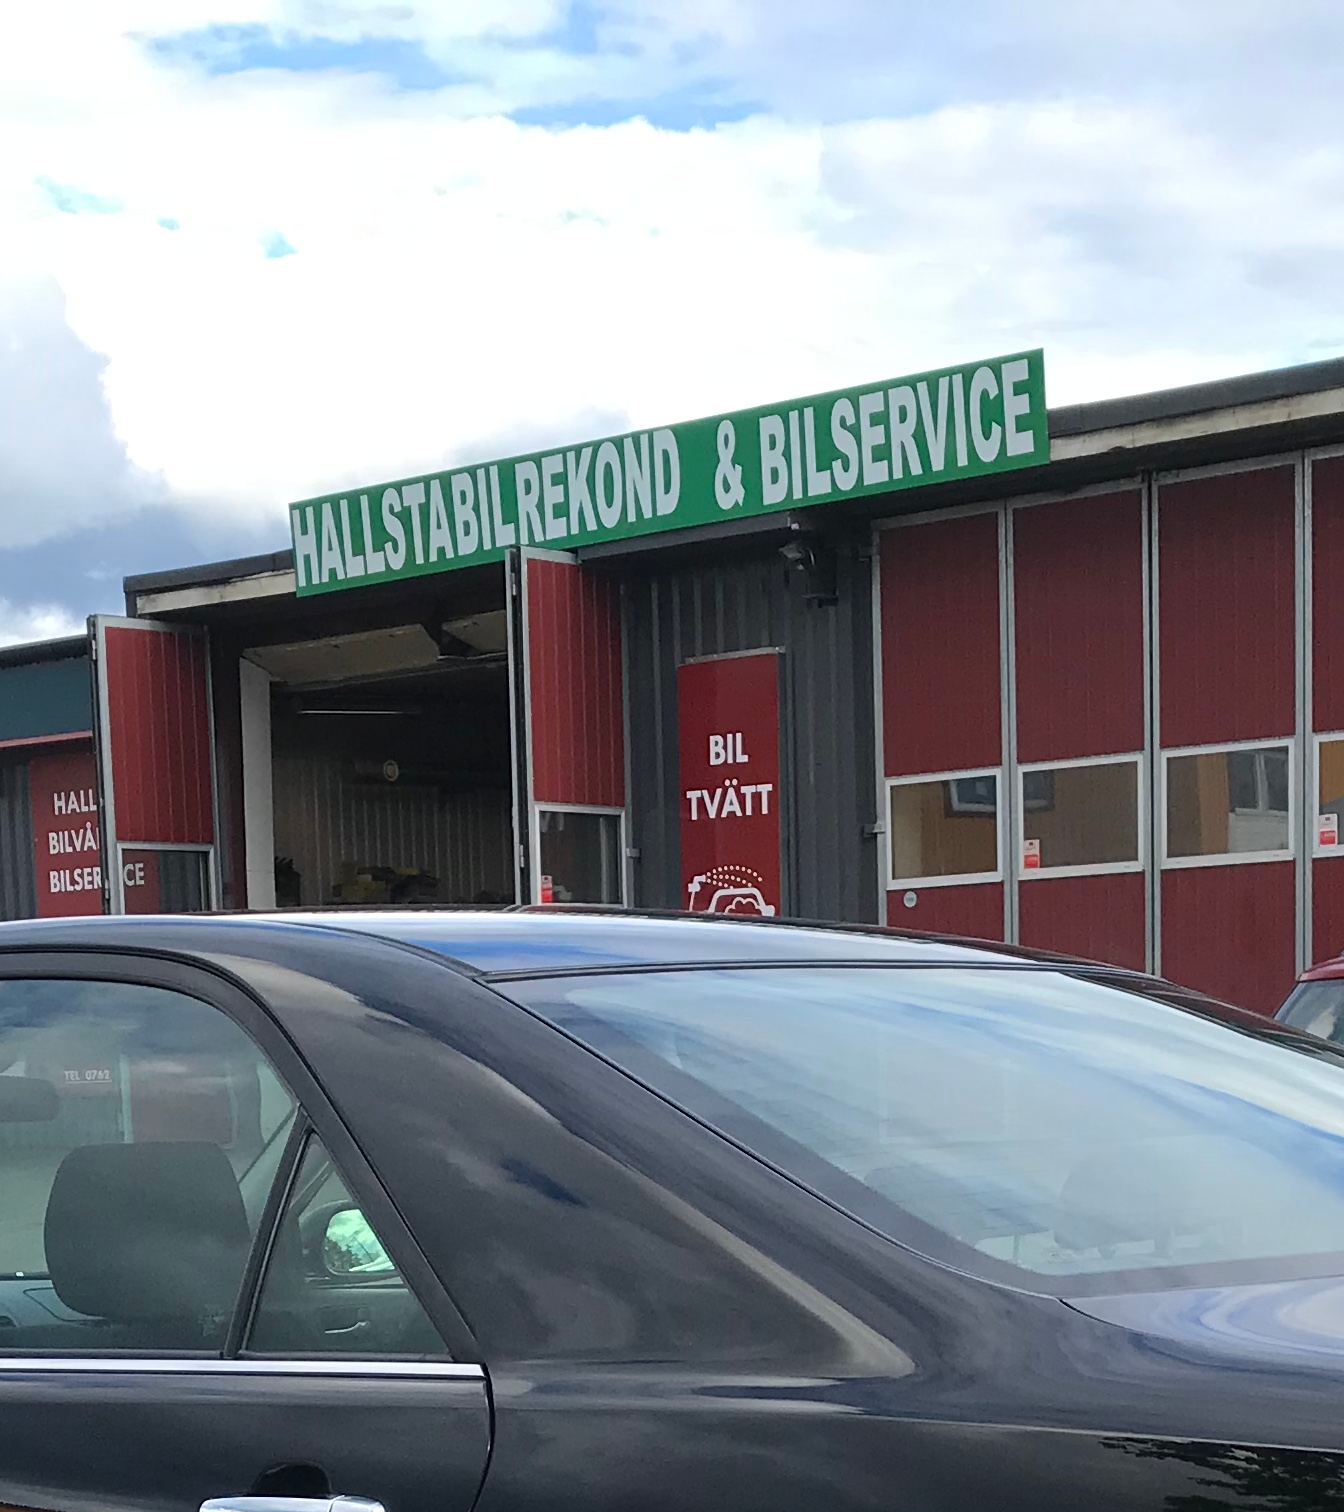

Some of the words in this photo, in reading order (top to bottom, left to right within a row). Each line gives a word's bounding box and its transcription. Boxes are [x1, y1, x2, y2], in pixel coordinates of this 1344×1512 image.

[714, 419, 746, 511] &
[759, 358, 1035, 506] BILSERVICE
[709, 732, 749, 766] BIL
[53, 788, 98, 816] HALL
[686, 778, 773, 821] TVÄTT
[48, 821, 100, 855] BILVÅ
